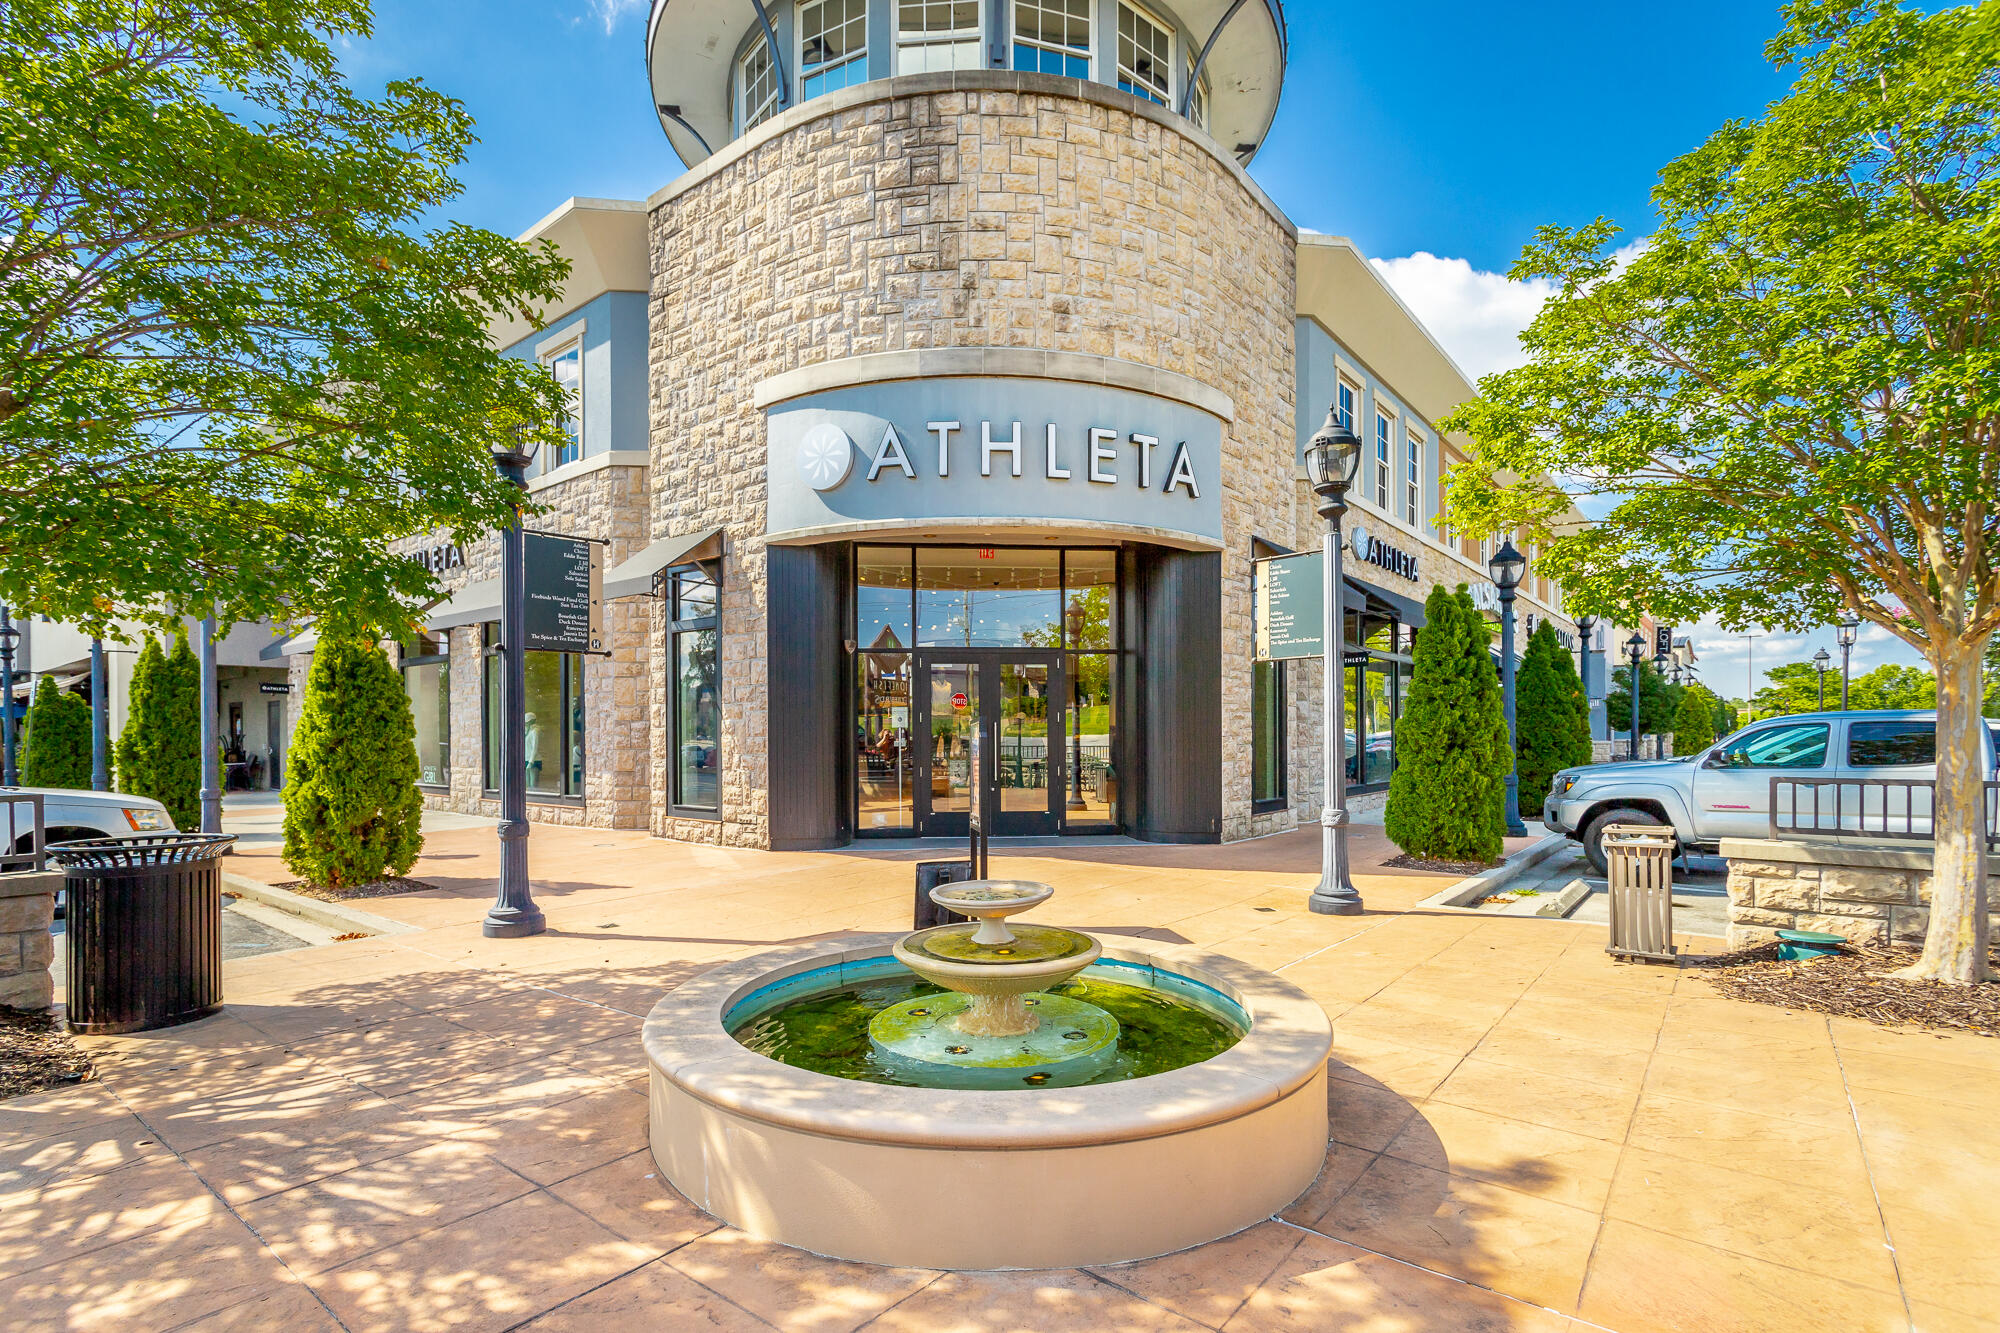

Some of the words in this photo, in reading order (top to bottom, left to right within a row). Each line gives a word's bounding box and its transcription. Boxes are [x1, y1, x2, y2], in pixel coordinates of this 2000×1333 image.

[866, 420, 1200, 498] ATHLETA
[1369, 536, 1419, 582] ATHLETA
[1660, 629, 1669, 652] LOFT
